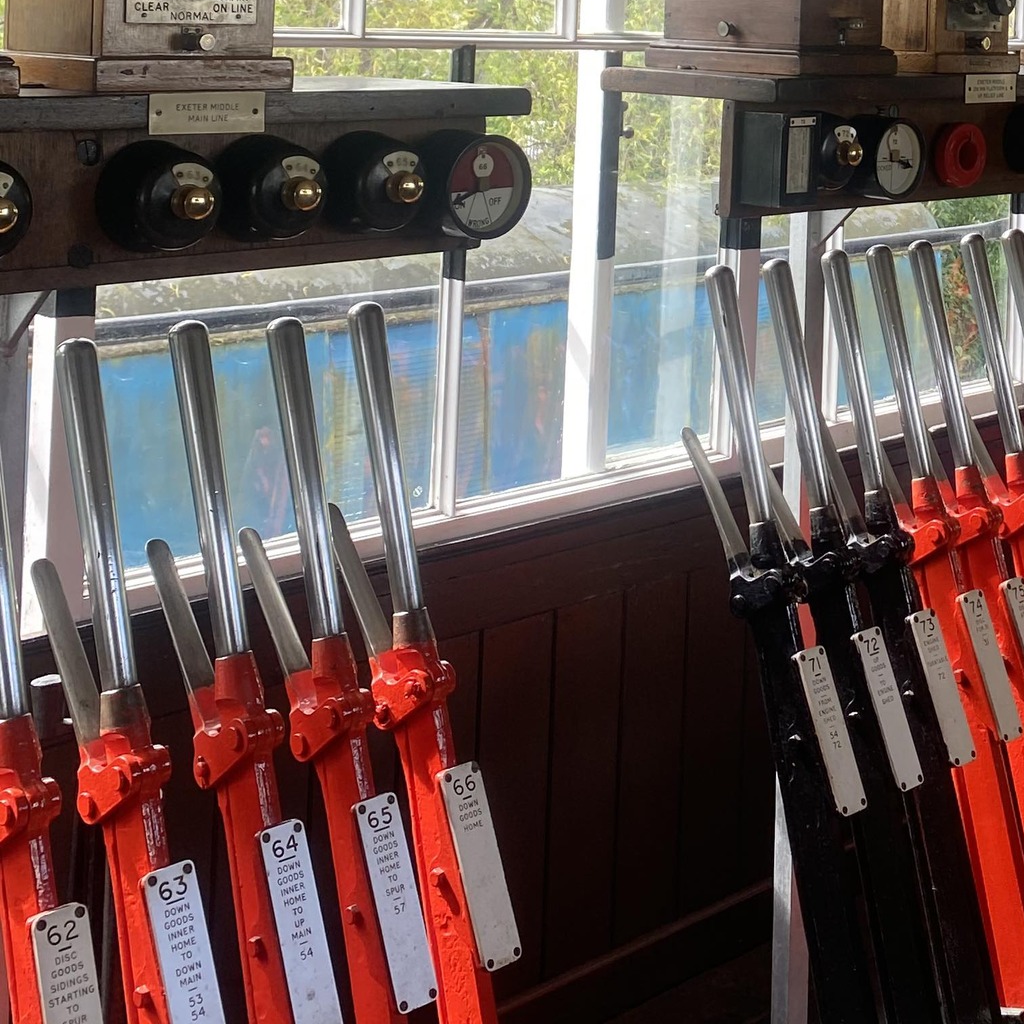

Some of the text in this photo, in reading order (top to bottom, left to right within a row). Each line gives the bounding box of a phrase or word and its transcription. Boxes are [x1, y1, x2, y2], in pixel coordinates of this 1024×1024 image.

[134, 2, 169, 12] CLEAR
[213, 4, 253, 13] ON LINE
[170, 12, 214, 21] NORMAL
[176, 103, 240, 112] EXETER MIDDLE
[211, 114, 229, 122] LINE
[489, 197, 501, 206] OFF
[468, 218, 490, 228] WRONG
[969, 598, 983, 614] 74
[920, 617, 935, 633] 73
[864, 637, 879, 653] 72
[809, 657, 822, 672] 71
[812, 677, 826, 686] DOWN
[453, 774, 476, 796] 66
[459, 799, 479, 811] DOWN
[368, 806, 393, 828] 65
[459, 808, 483, 822] GOODS
[464, 820, 483, 832] HOME
[373, 831, 395, 844] DOWN
[272, 835, 298, 858] 64
[373, 841, 398, 855] GOODS
[377, 852, 399, 865] INNER
[277, 860, 301, 875] DOWN
[379, 862, 401, 875] HOME
[277, 870, 304, 886] GOODS
[388, 874, 398, 883] TO
[159, 875, 187, 900] 63
[281, 882, 305, 897] INNER
[386, 884, 405, 896] SPUR
[283, 893, 307, 907] HOME
[164, 902, 190, 918] DOWN
[292, 907, 303, 916] TO
[394, 903, 405, 915] 57
[164, 913, 194, 930] GOODS
[294, 918, 305, 928] UP
[46, 920, 79, 946] 62
[168, 925, 194, 941] INNER
[291, 927, 312, 941] MAIN
[171, 936, 196, 952] HOME
[54, 951, 77, 966] DISC
[181, 951, 193, 961] TO
[300, 947, 313, 960] 54
[50, 962, 84, 979] GOODS
[176, 960, 202, 976] DOWN
[50, 973, 89, 993] SIDINGS
[179, 972, 202, 988] MAIN
[48, 985, 95, 1008] STARTING
[188, 993, 203, 1007] 53
[66, 1004, 80, 1014] TO
[191, 1006, 206, 1021] 54
